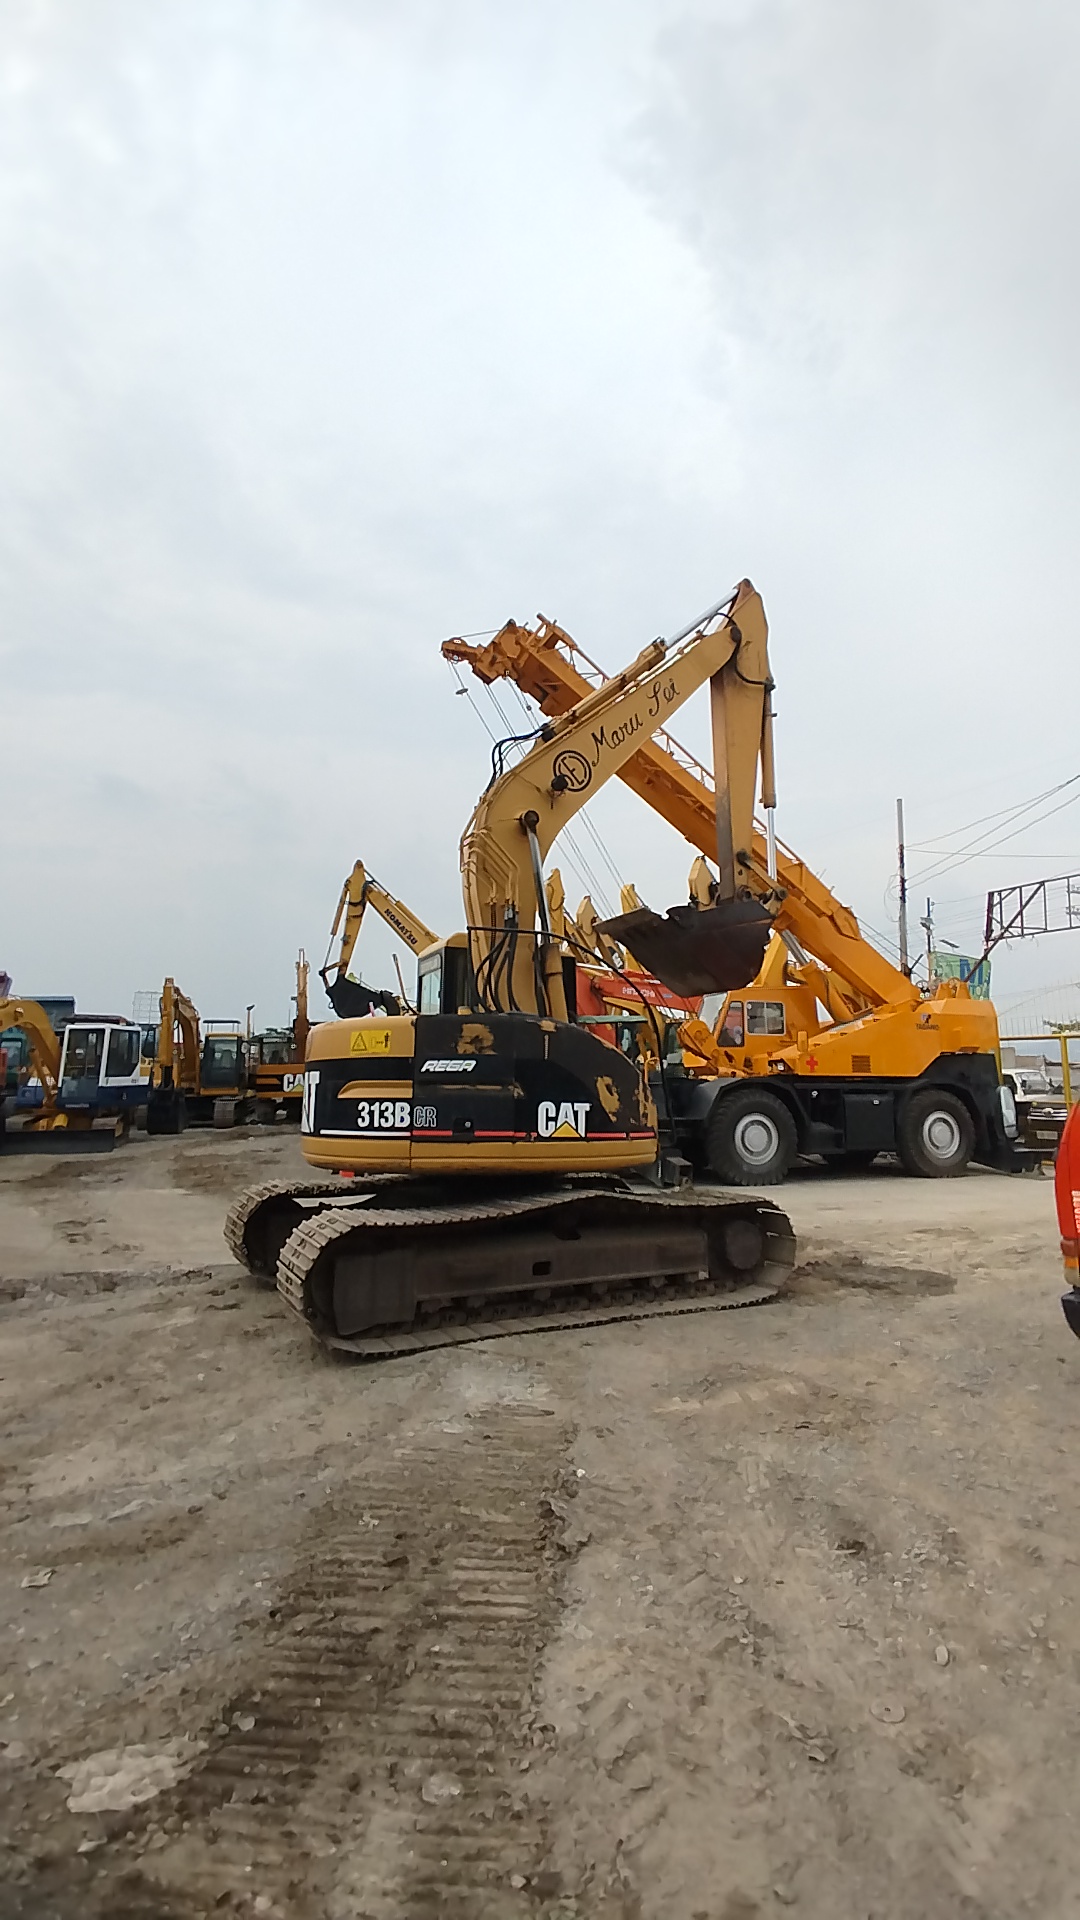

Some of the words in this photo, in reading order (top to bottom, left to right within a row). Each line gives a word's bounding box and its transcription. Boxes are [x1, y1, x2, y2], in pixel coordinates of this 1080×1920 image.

[591, 713, 643, 767] Maru
[384, 908, 418, 945] KOMATSU
[283, 1073, 304, 1093] CA
[357, 1101, 411, 1128] 313B
[413, 1105, 437, 1128] CR
[537, 1100, 592, 1138] CAT
